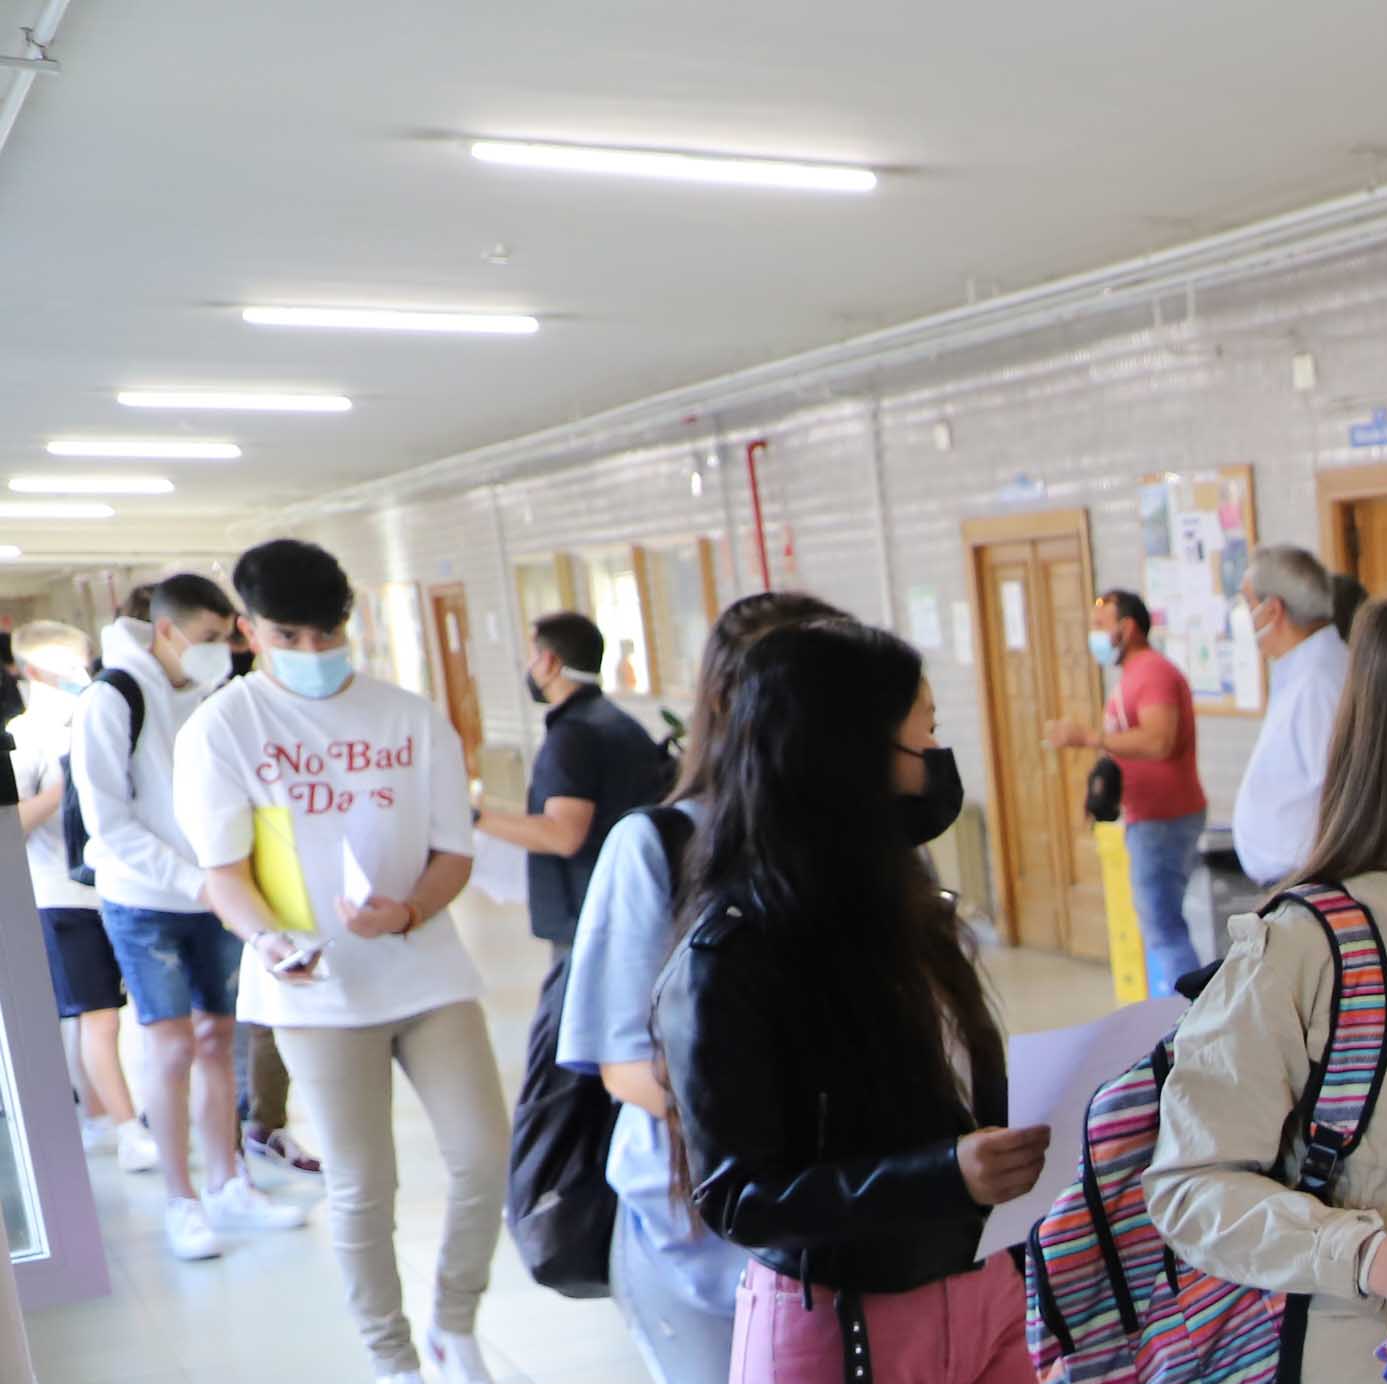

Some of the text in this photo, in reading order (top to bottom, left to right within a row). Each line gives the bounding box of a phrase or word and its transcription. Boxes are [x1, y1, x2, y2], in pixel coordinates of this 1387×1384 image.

[256, 736, 413, 784] No Bad
[289, 780, 395, 814] Das
